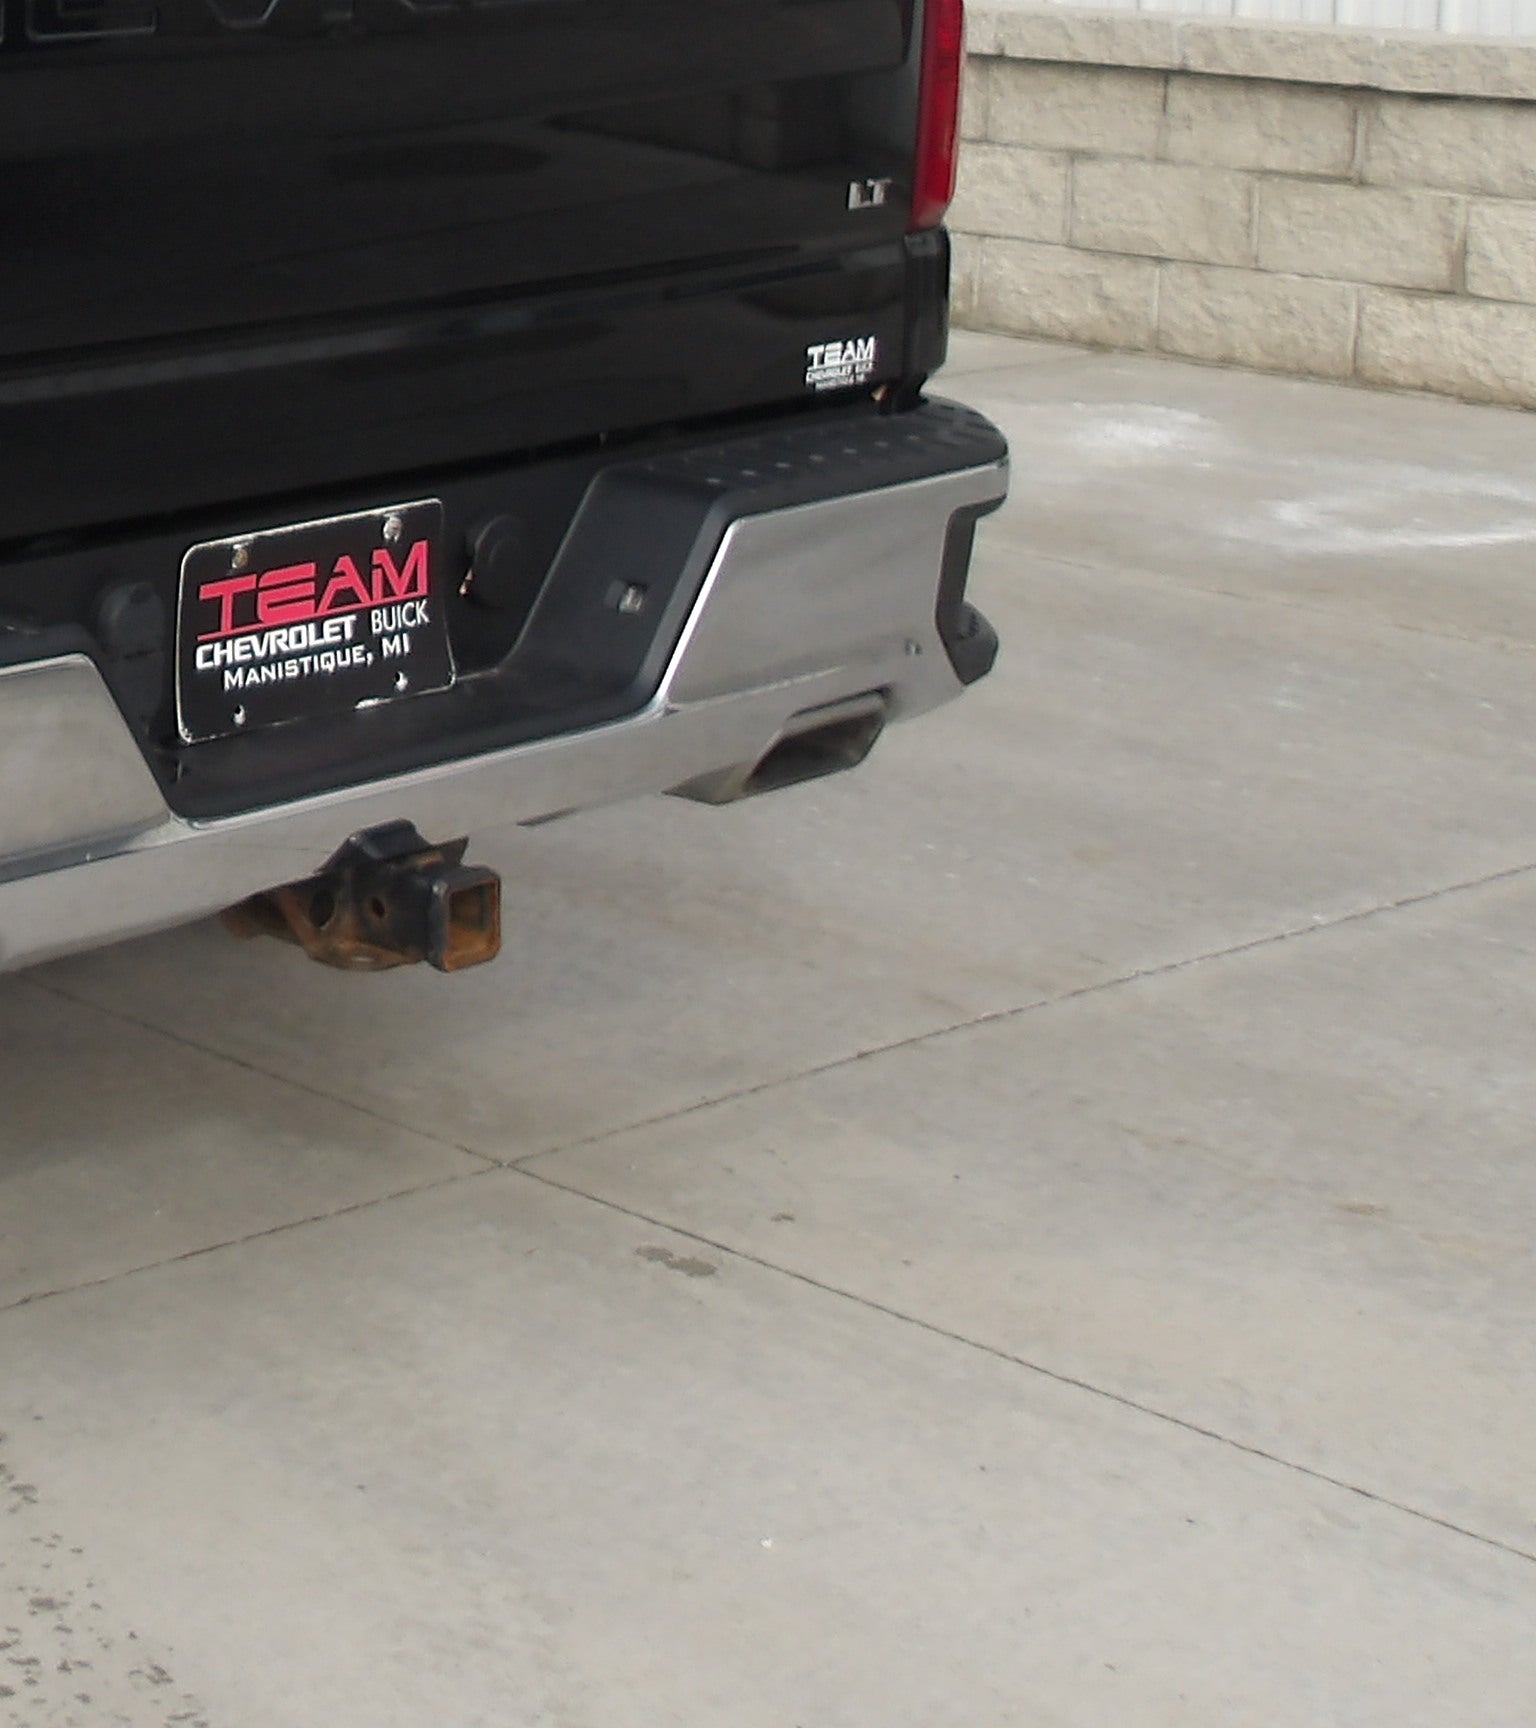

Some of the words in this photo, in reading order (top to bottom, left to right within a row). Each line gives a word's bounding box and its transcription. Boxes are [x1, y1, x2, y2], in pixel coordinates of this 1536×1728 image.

[846, 178, 893, 210] LT
[807, 335, 876, 370] TEAM
[197, 539, 428, 636] TEAM
[195, 615, 357, 670] CHEVROLET
[371, 598, 430, 635] BUICK
[223, 644, 374, 691] MANISTIQUE,
[381, 633, 411, 659] MI
